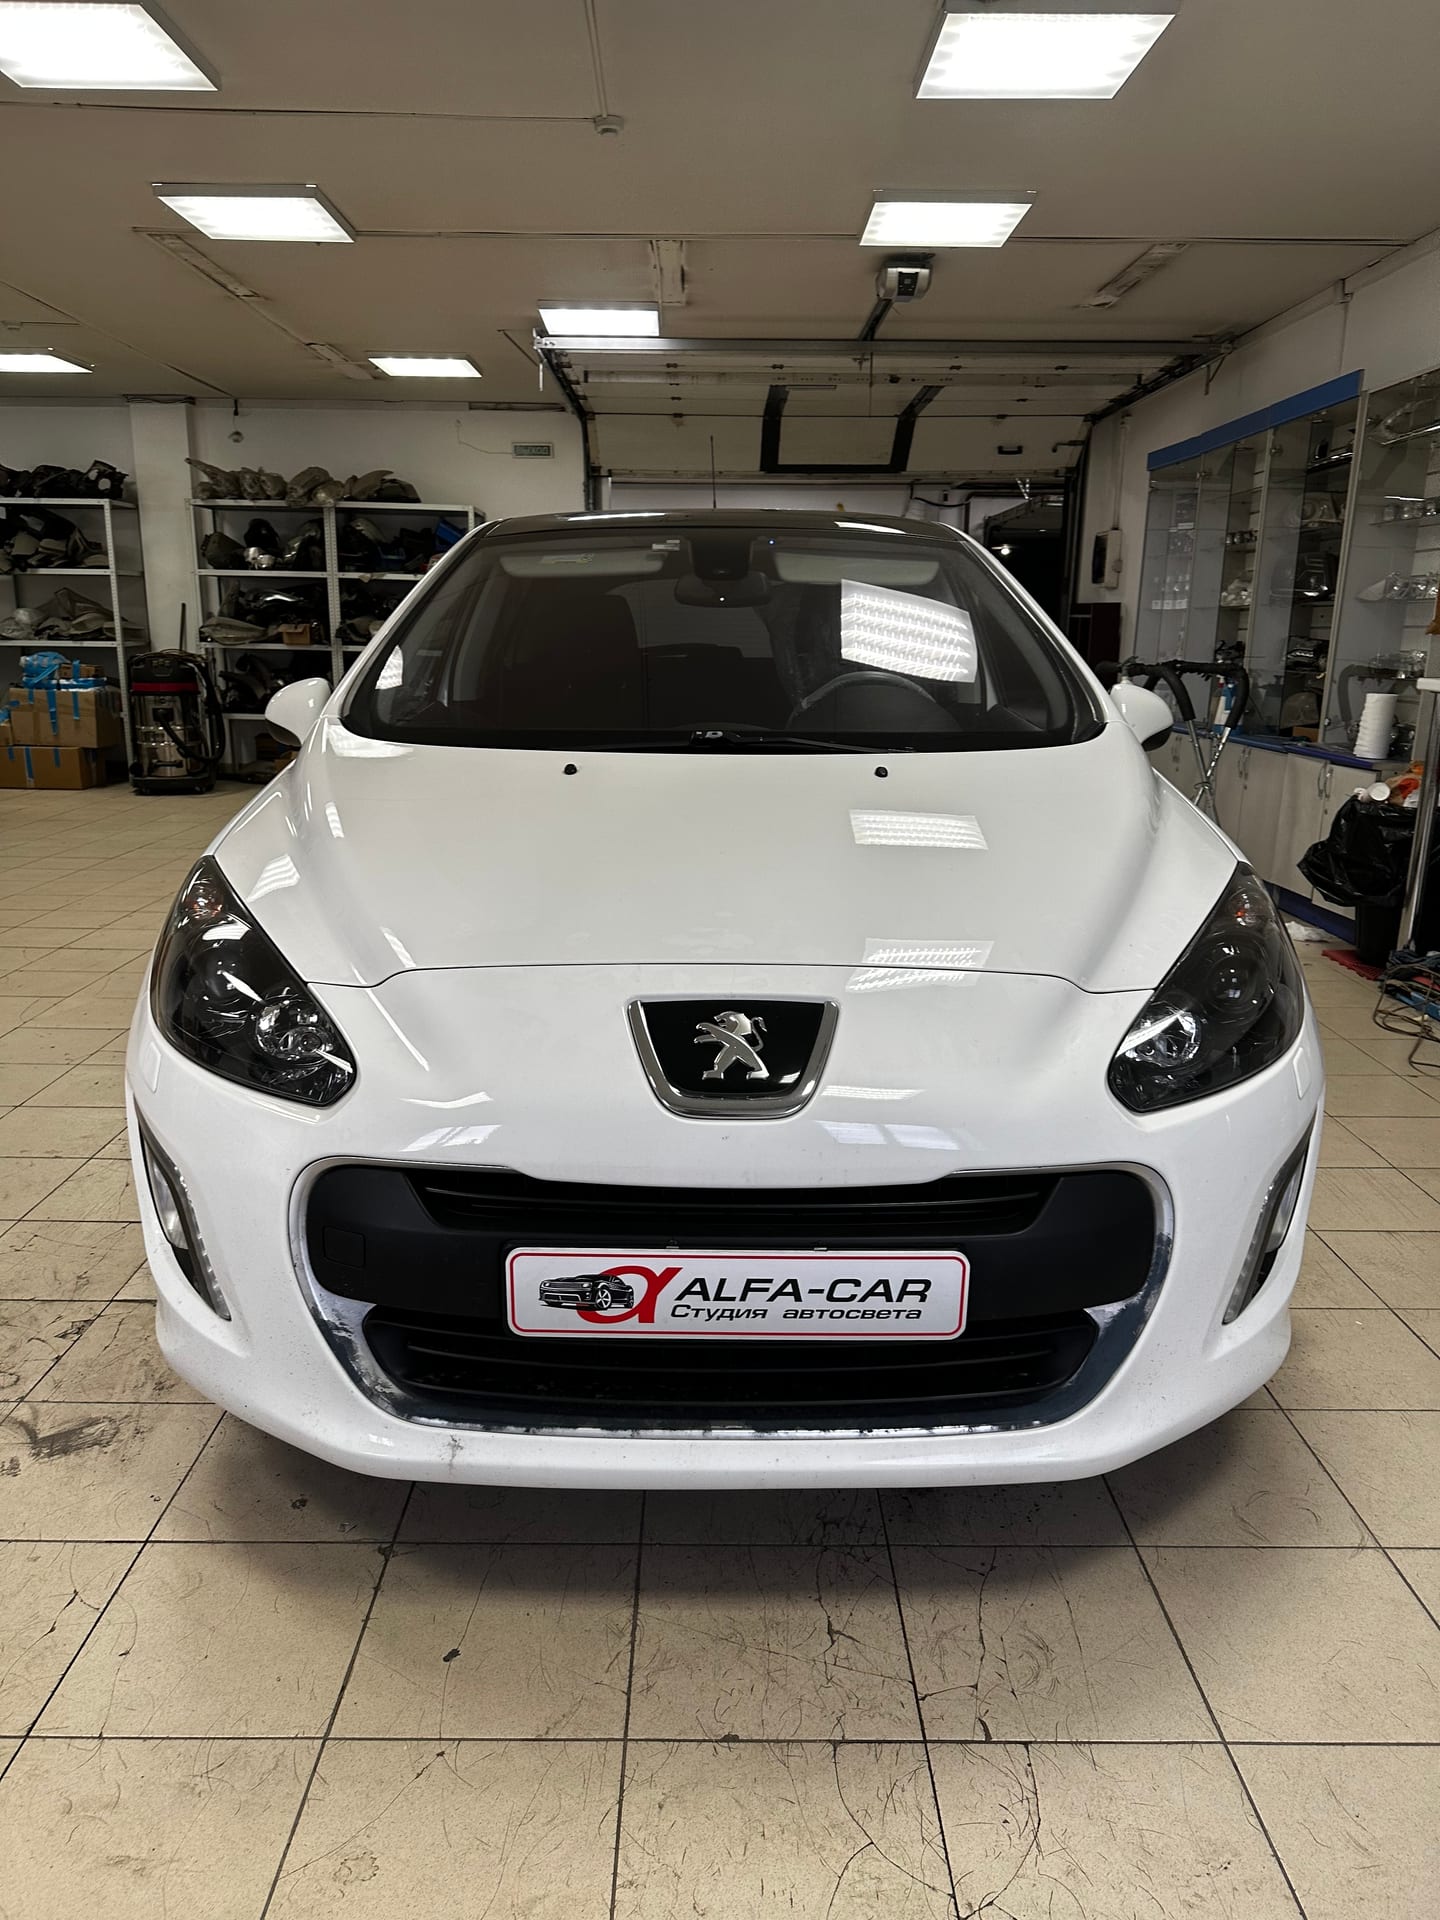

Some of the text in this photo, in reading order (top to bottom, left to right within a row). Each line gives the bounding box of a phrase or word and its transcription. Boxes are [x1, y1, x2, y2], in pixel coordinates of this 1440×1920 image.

[674, 1277, 932, 1303] ALFA-CAR
[671, 1304, 922, 1322] Студия автосвета
